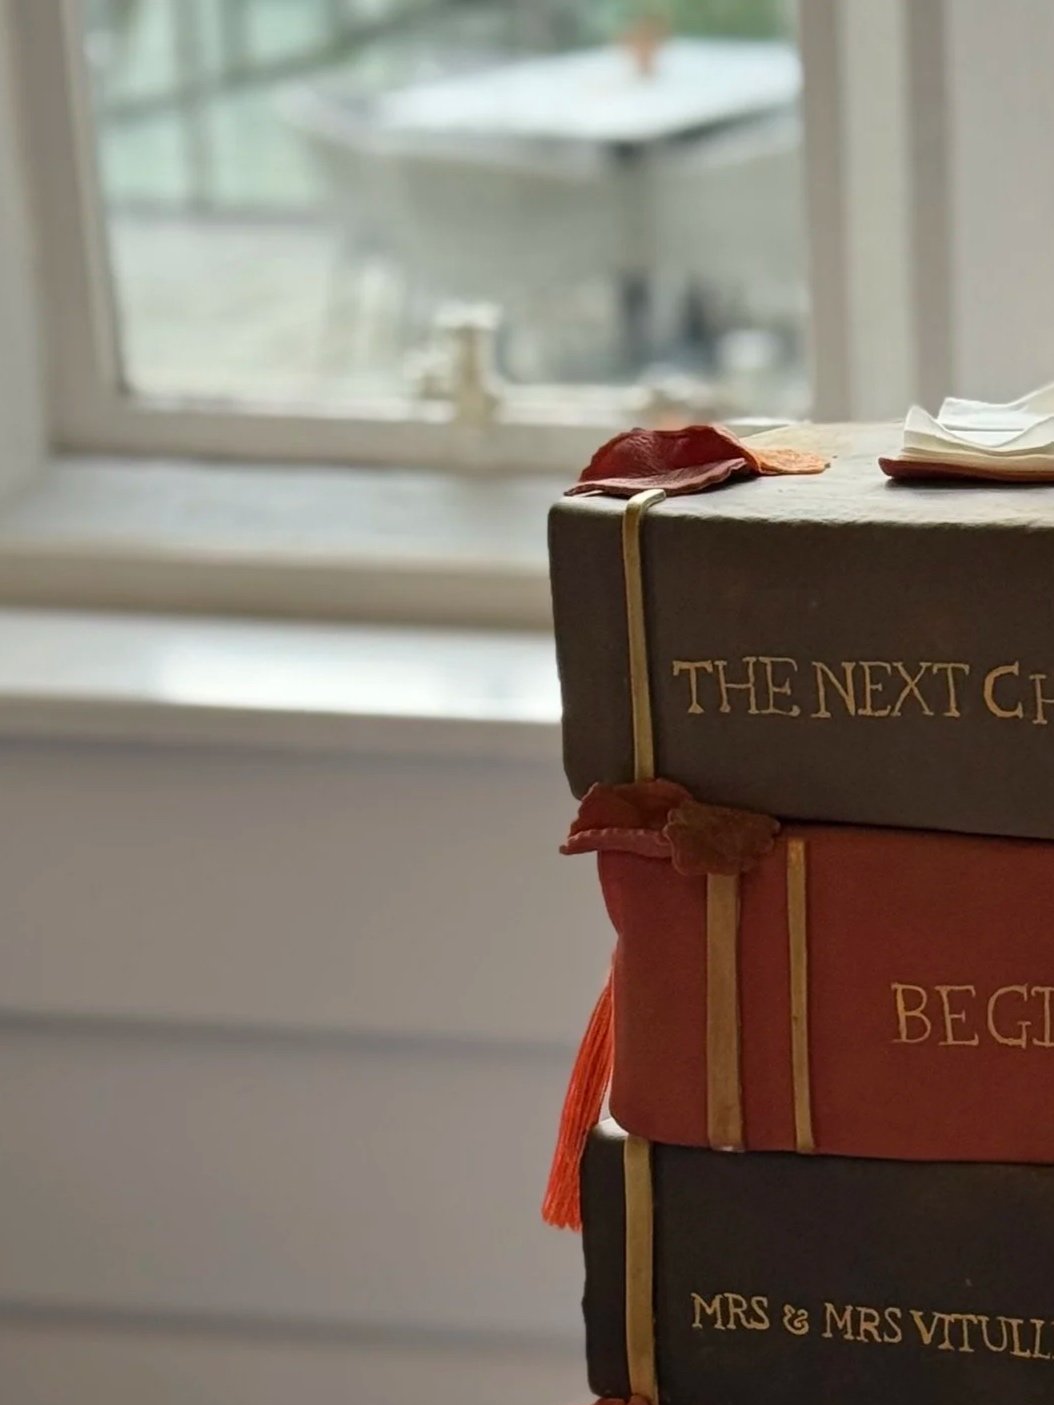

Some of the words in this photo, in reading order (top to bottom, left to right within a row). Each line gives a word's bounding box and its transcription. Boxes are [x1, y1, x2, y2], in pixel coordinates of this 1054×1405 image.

[673, 656, 800, 716] THE
[810, 661, 970, 718] NEXT
[691, 1293, 770, 1331] MRS
[782, 1303, 810, 1335] &
[821, 1302, 902, 1343] MRS
